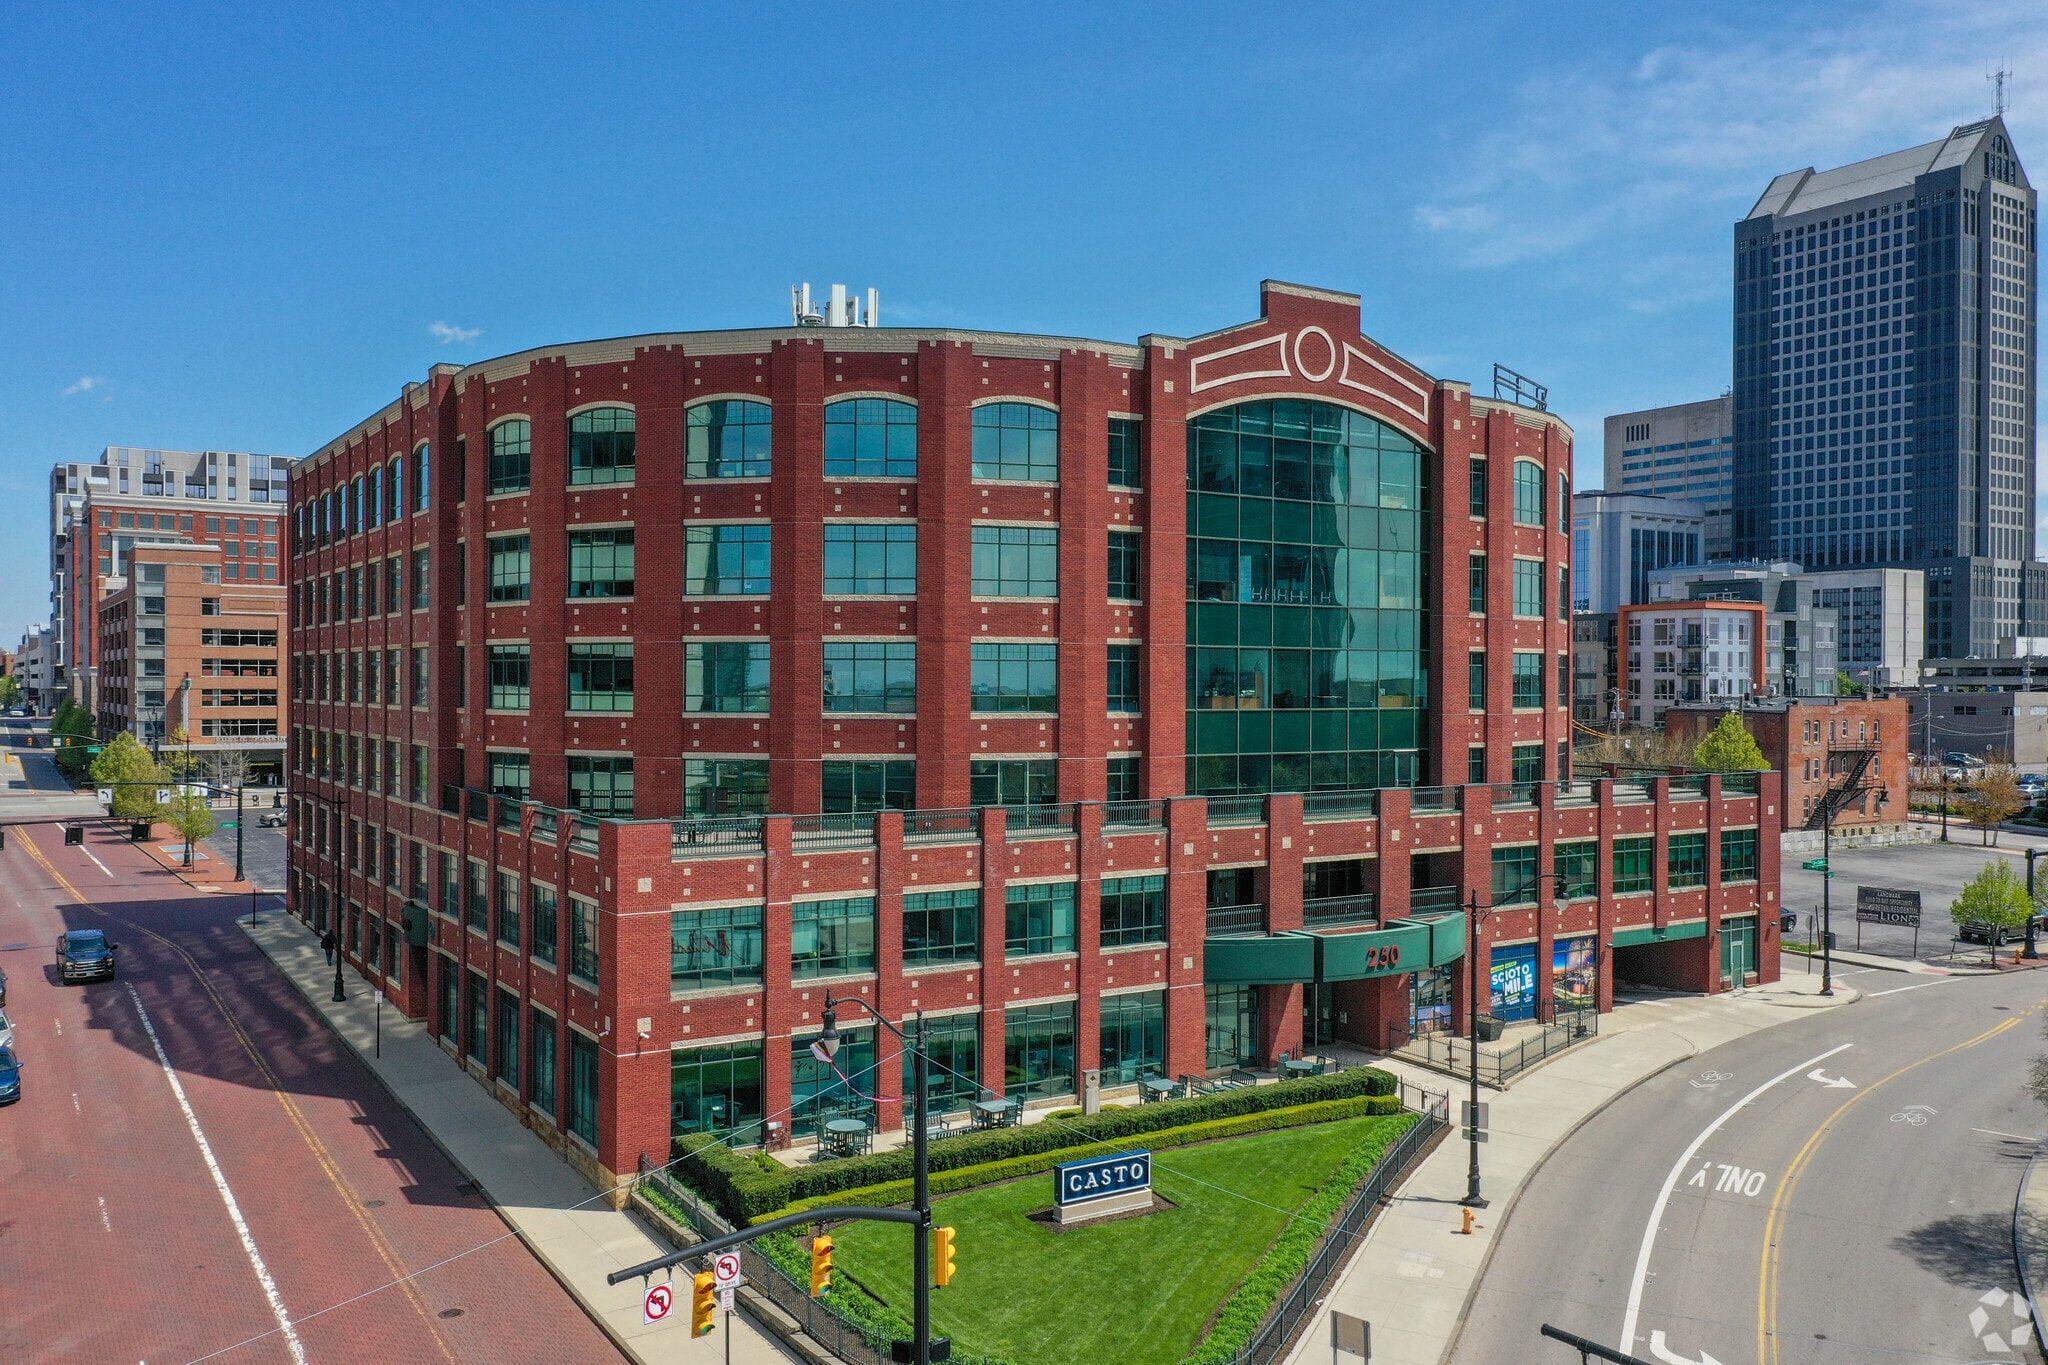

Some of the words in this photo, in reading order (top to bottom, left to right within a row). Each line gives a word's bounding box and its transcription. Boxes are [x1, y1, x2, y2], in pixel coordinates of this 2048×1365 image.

[1880, 911, 1908, 922] LION
[1368, 945, 1401, 967] 250
[1491, 964, 1530, 985] SCIOTO
[1503, 974, 1534, 996] MILE
[1069, 1163, 1144, 1192] CASTO
[1688, 1161, 1767, 1197] ONLY
